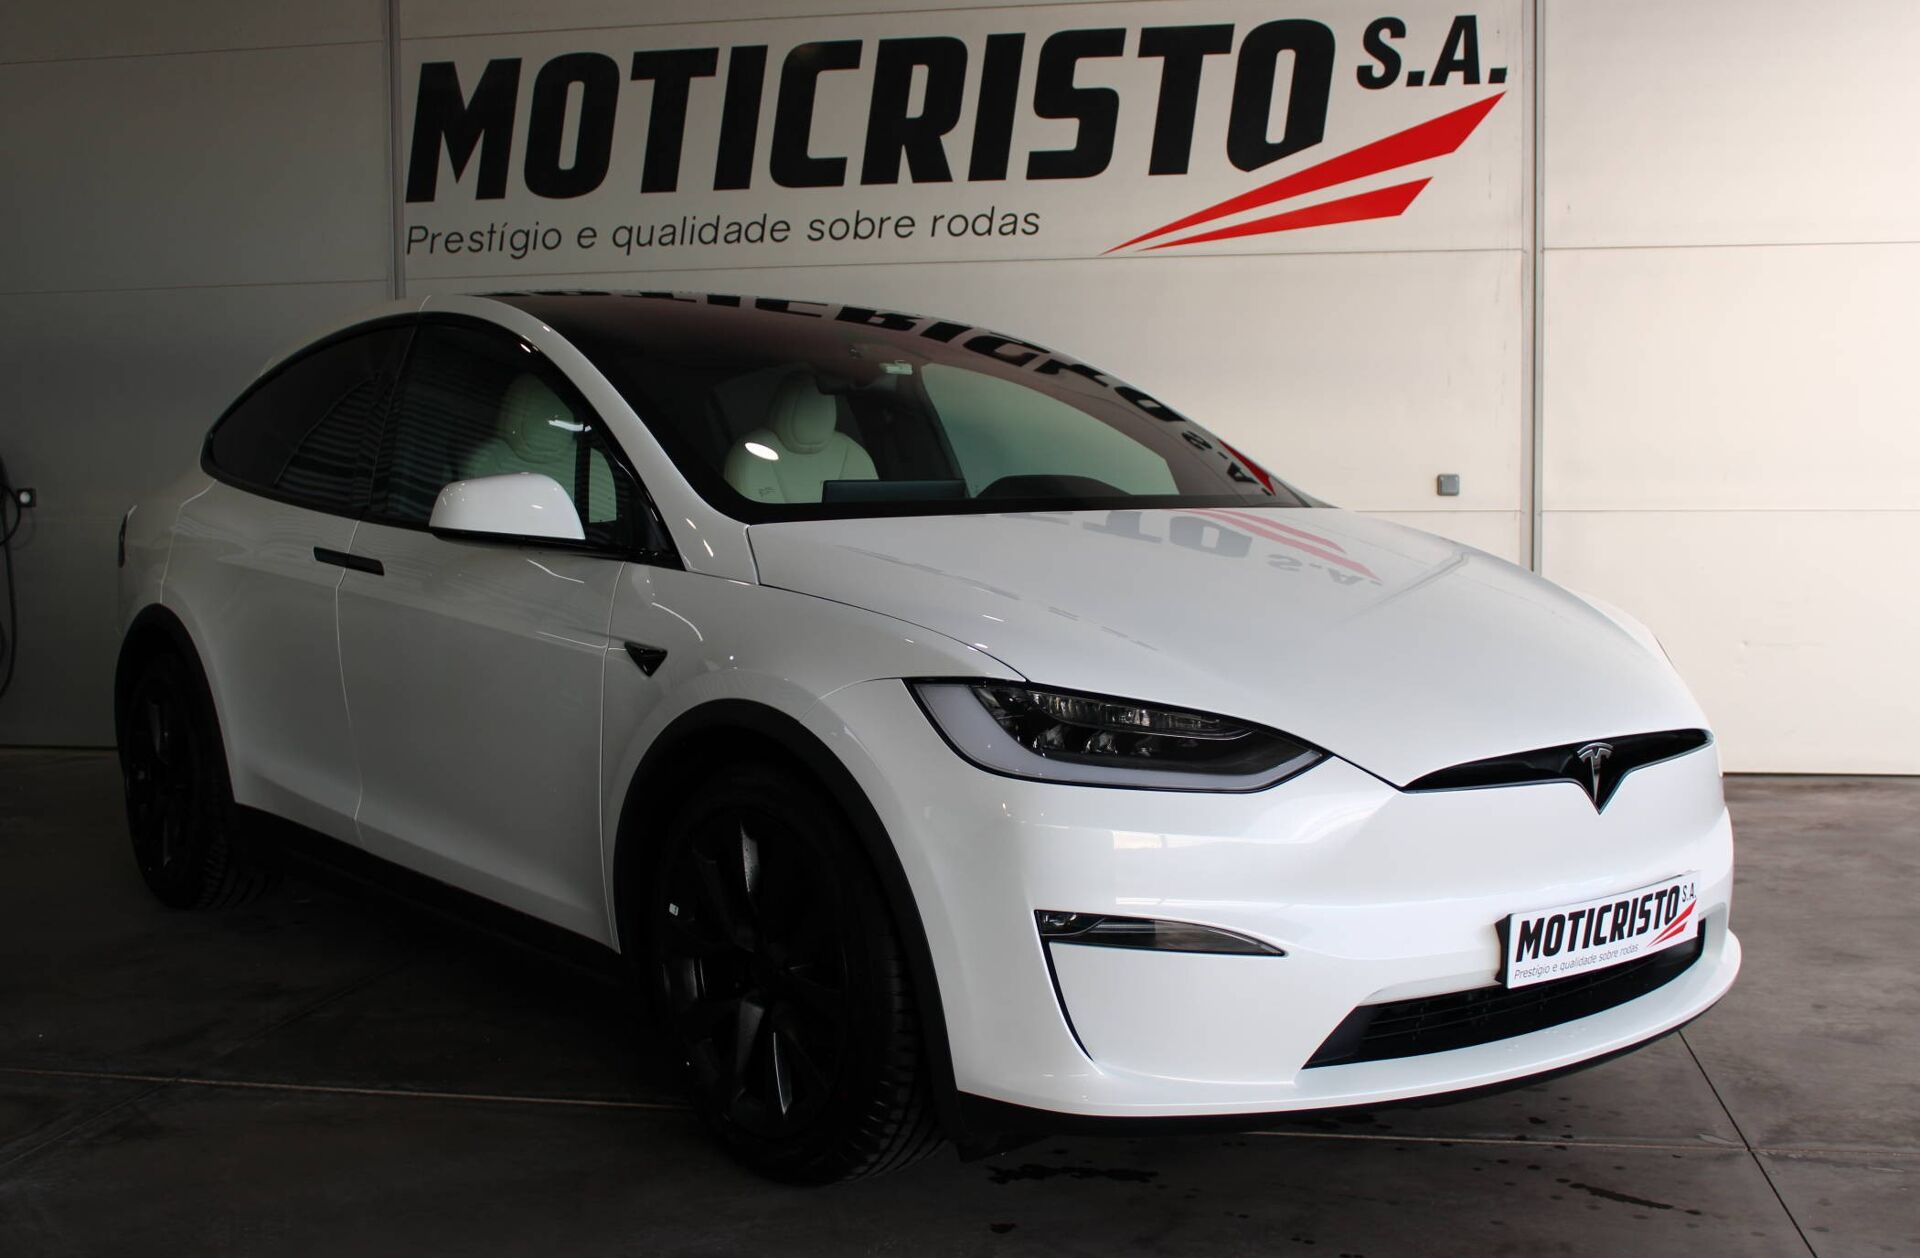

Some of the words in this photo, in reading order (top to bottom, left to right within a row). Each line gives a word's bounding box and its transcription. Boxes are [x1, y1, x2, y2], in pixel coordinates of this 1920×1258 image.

[404, 18, 1336, 204] MOTICRISTO
[1355, 14, 1508, 90] S.A.
[406, 223, 563, 260] Prestígio
[577, 225, 598, 249] e
[611, 213, 792, 256] qualidade
[806, 209, 917, 241] sobre
[930, 205, 1042, 238] rodas
[1515, 885, 1681, 963] MOTICRISTO
[1552, 963, 1558, 973] e
[1560, 954, 1597, 970] qualidade
[1599, 948, 1619, 962] sobre
[1619, 943, 1639, 957] rodas
